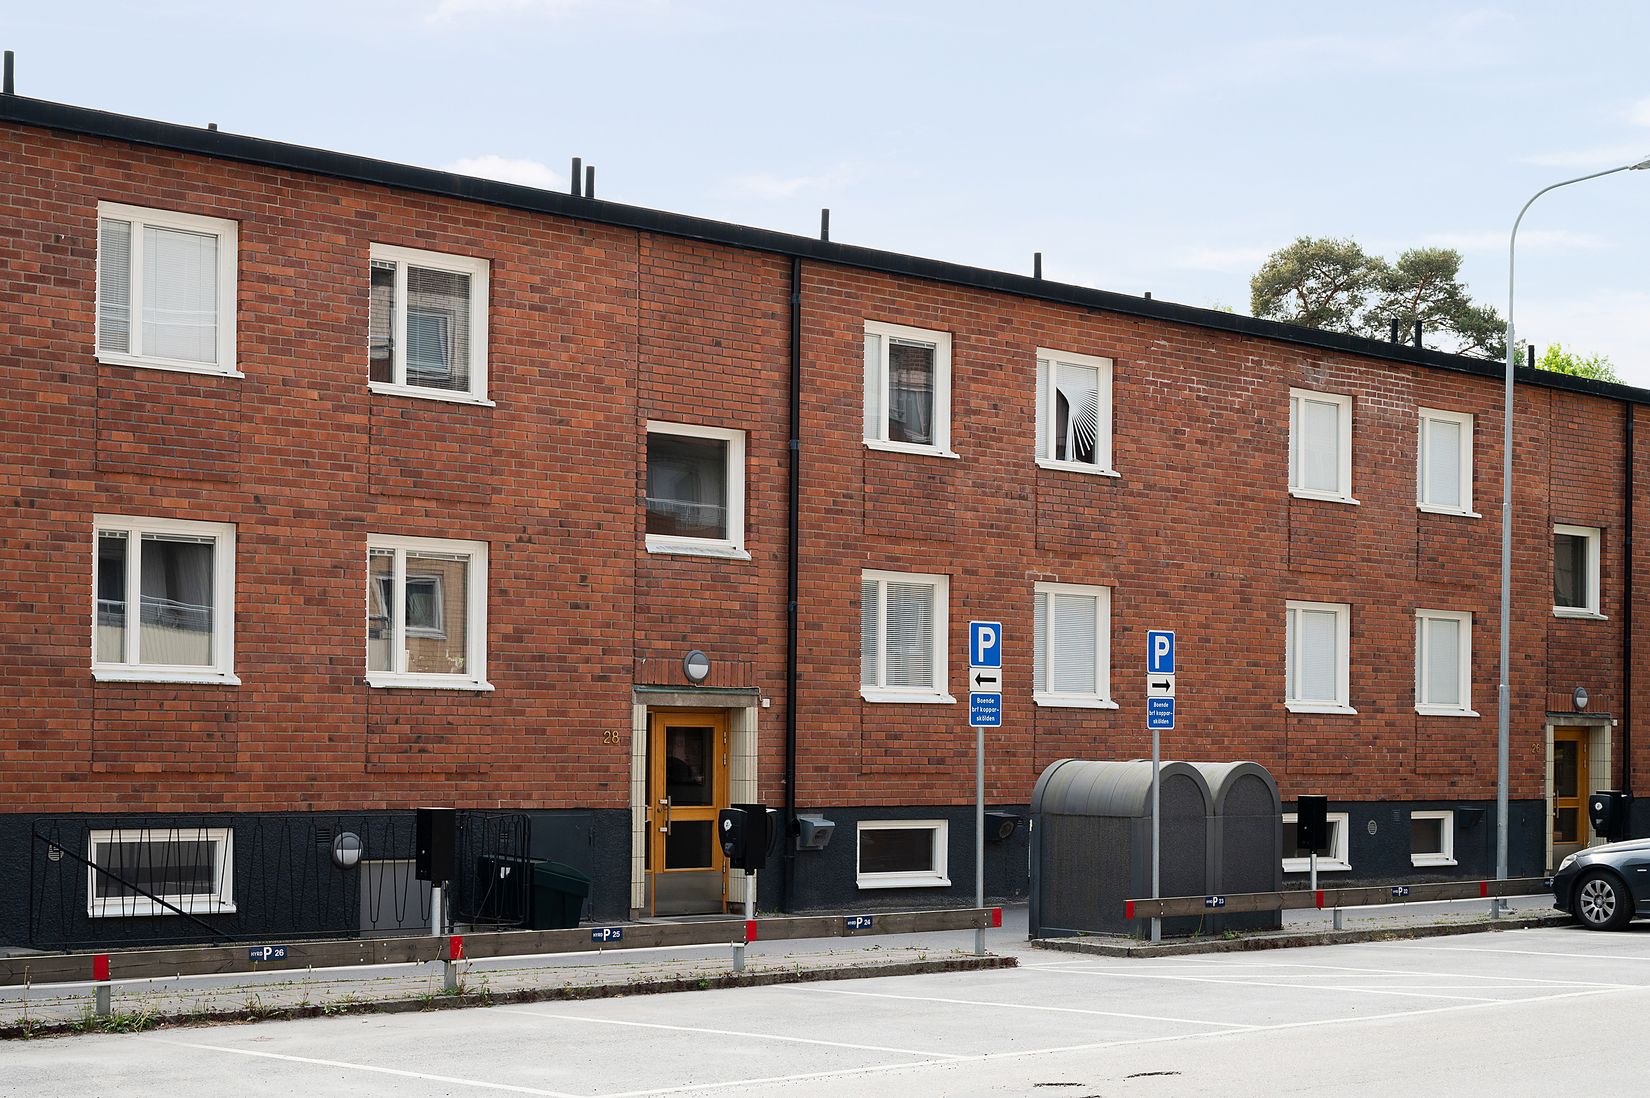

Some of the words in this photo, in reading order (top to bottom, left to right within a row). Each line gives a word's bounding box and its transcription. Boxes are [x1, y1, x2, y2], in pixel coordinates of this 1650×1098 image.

[978, 626, 996, 662] P
[1155, 635, 1170, 669] P
[603, 730, 620, 744] 28
[1398, 886, 1403, 897] P
[1212, 896, 1218, 907] P
[856, 917, 863, 929] P
[863, 918, 871, 926] 24
[603, 928, 611, 942] P
[612, 930, 621, 938] 25
[263, 946, 273, 961] P
[274, 948, 285, 957] 26
